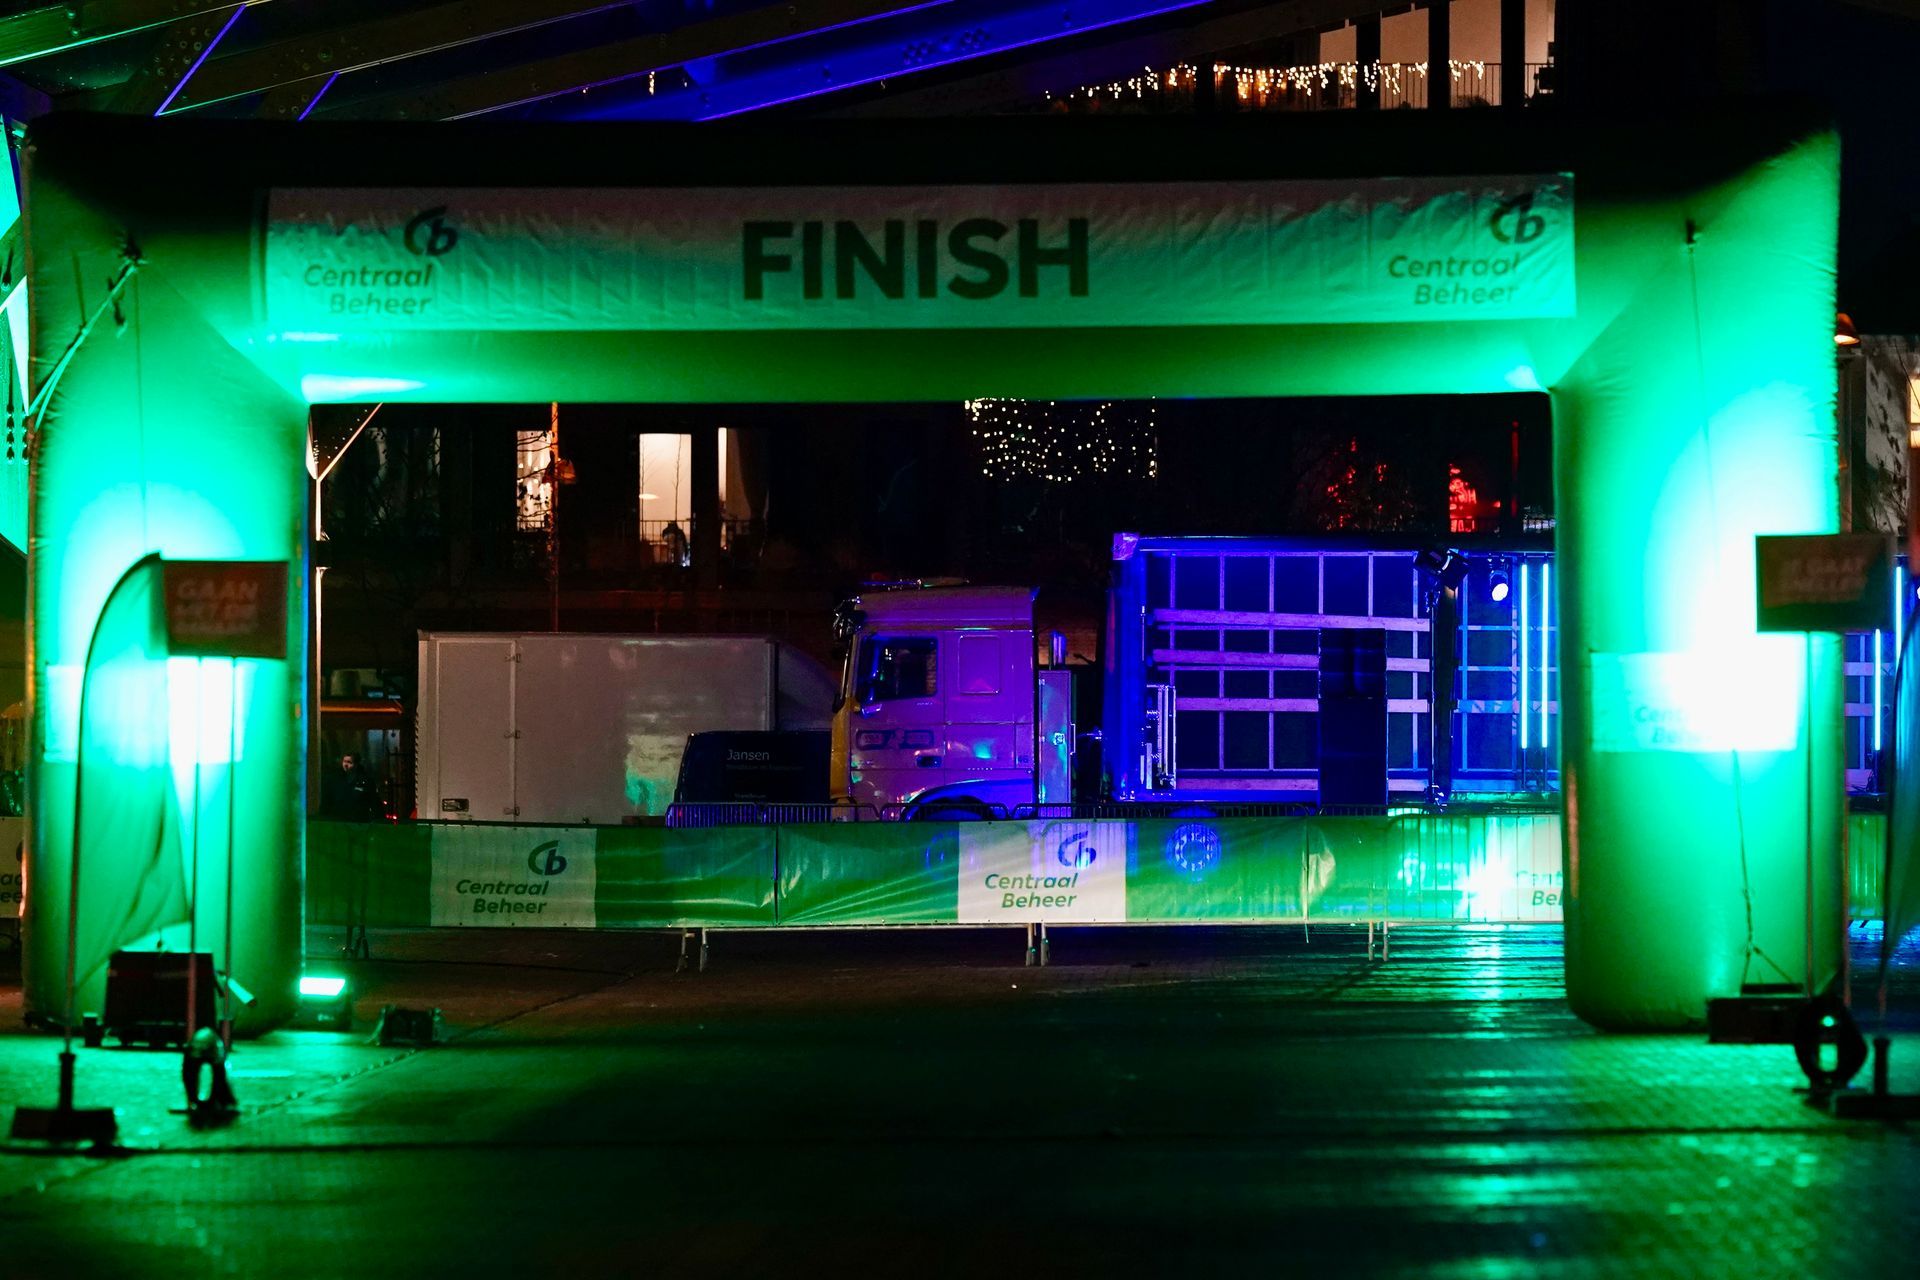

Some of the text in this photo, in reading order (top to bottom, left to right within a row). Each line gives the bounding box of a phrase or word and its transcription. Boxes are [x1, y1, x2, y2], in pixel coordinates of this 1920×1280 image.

[743, 218, 1089, 299] FINISH
[1388, 252, 1520, 278] Centraal
[304, 263, 432, 287] Centraal
[330, 292, 432, 314] Beheer
[1414, 282, 1518, 305] Beheer
[726, 749, 770, 761] Jansen
[456, 879, 549, 895] Centraal
[985, 873, 1078, 889] Centraal
[473, 899, 546, 914] Beheer
[1002, 892, 1077, 908] Beheer
